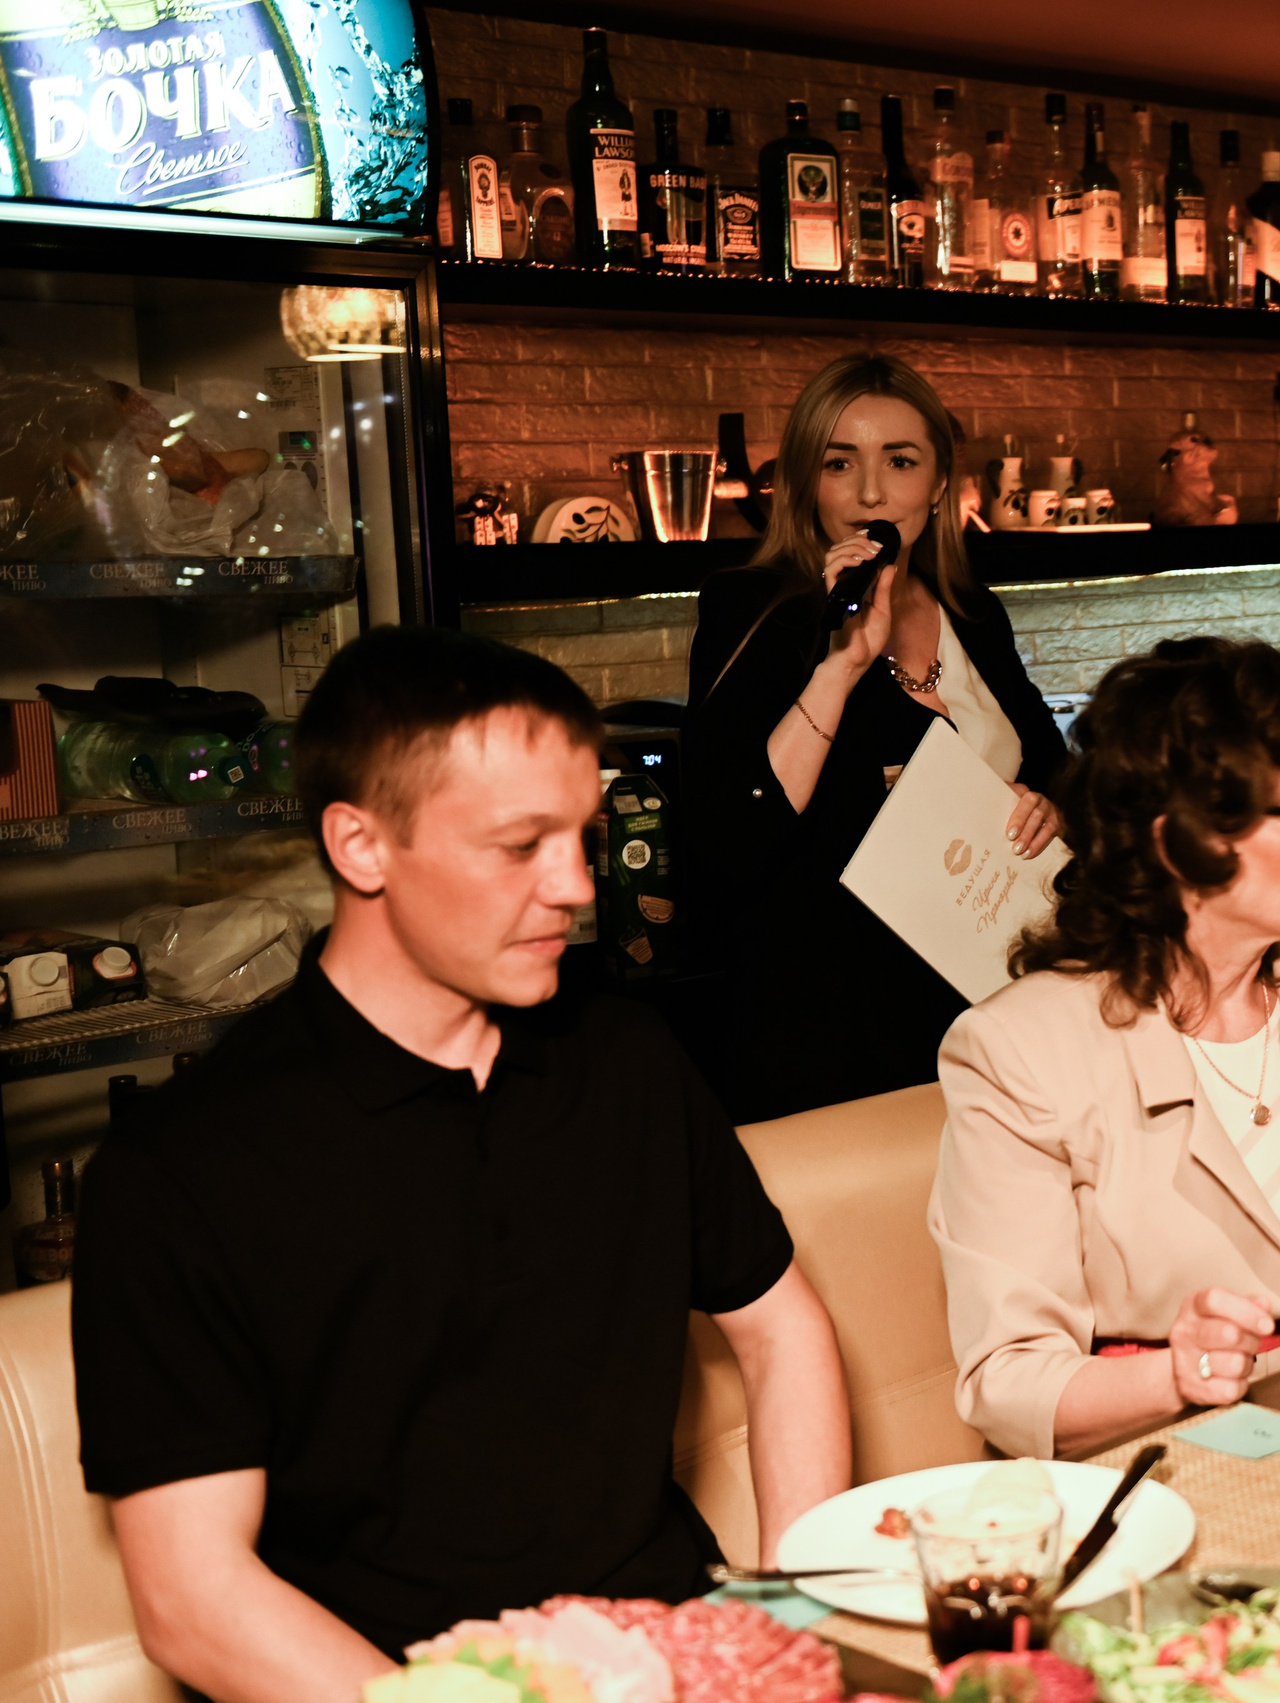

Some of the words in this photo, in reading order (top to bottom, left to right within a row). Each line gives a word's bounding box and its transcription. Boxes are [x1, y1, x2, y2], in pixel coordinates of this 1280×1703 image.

[85, 30, 225, 78] ЗОЛОТАЯ
[29, 49, 298, 162] БОЧКА
[104, 141, 250, 196] Светлое
[650, 174, 687, 188] GREEN
[0, 563, 39, 580] ЖЕЕ
[89, 562, 166, 580] СВЕЖЕЕ
[217, 560, 289, 578] СВЕЖЕЕ
[112, 808, 187, 829] СВЕЖЕЕ
[281, 810, 305, 822] ПИВ
[0, 823, 66, 841] ВЕЖЕЕ
[956, 849, 991, 906] ВЕДУЩАЯ
[136, 1021, 209, 1045] СВЕЖЕЕ
[10, 1043, 88, 1067] СВЕЖЕЕ
